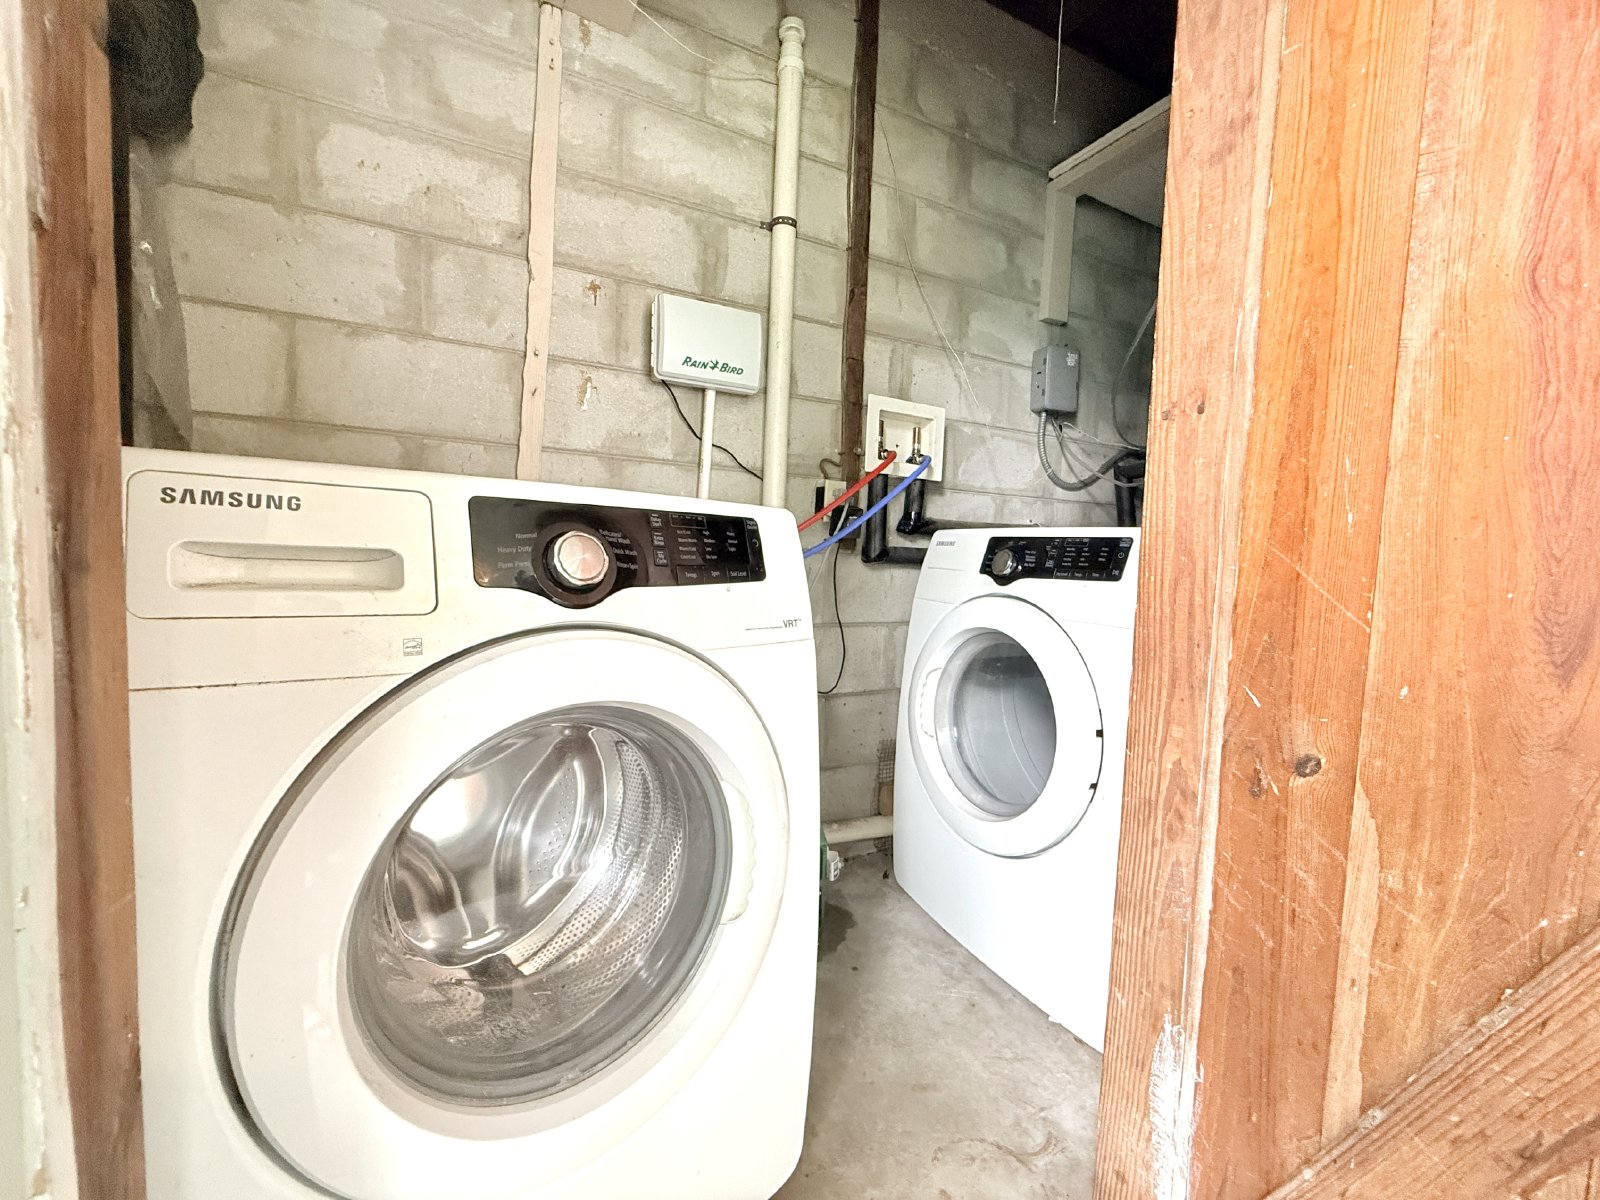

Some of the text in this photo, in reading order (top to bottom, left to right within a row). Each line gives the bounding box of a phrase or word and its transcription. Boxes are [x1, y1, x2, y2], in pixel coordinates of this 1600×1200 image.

[682, 356, 744, 376] RAIN BIRD
[160, 486, 301, 512] SAMSUNG
